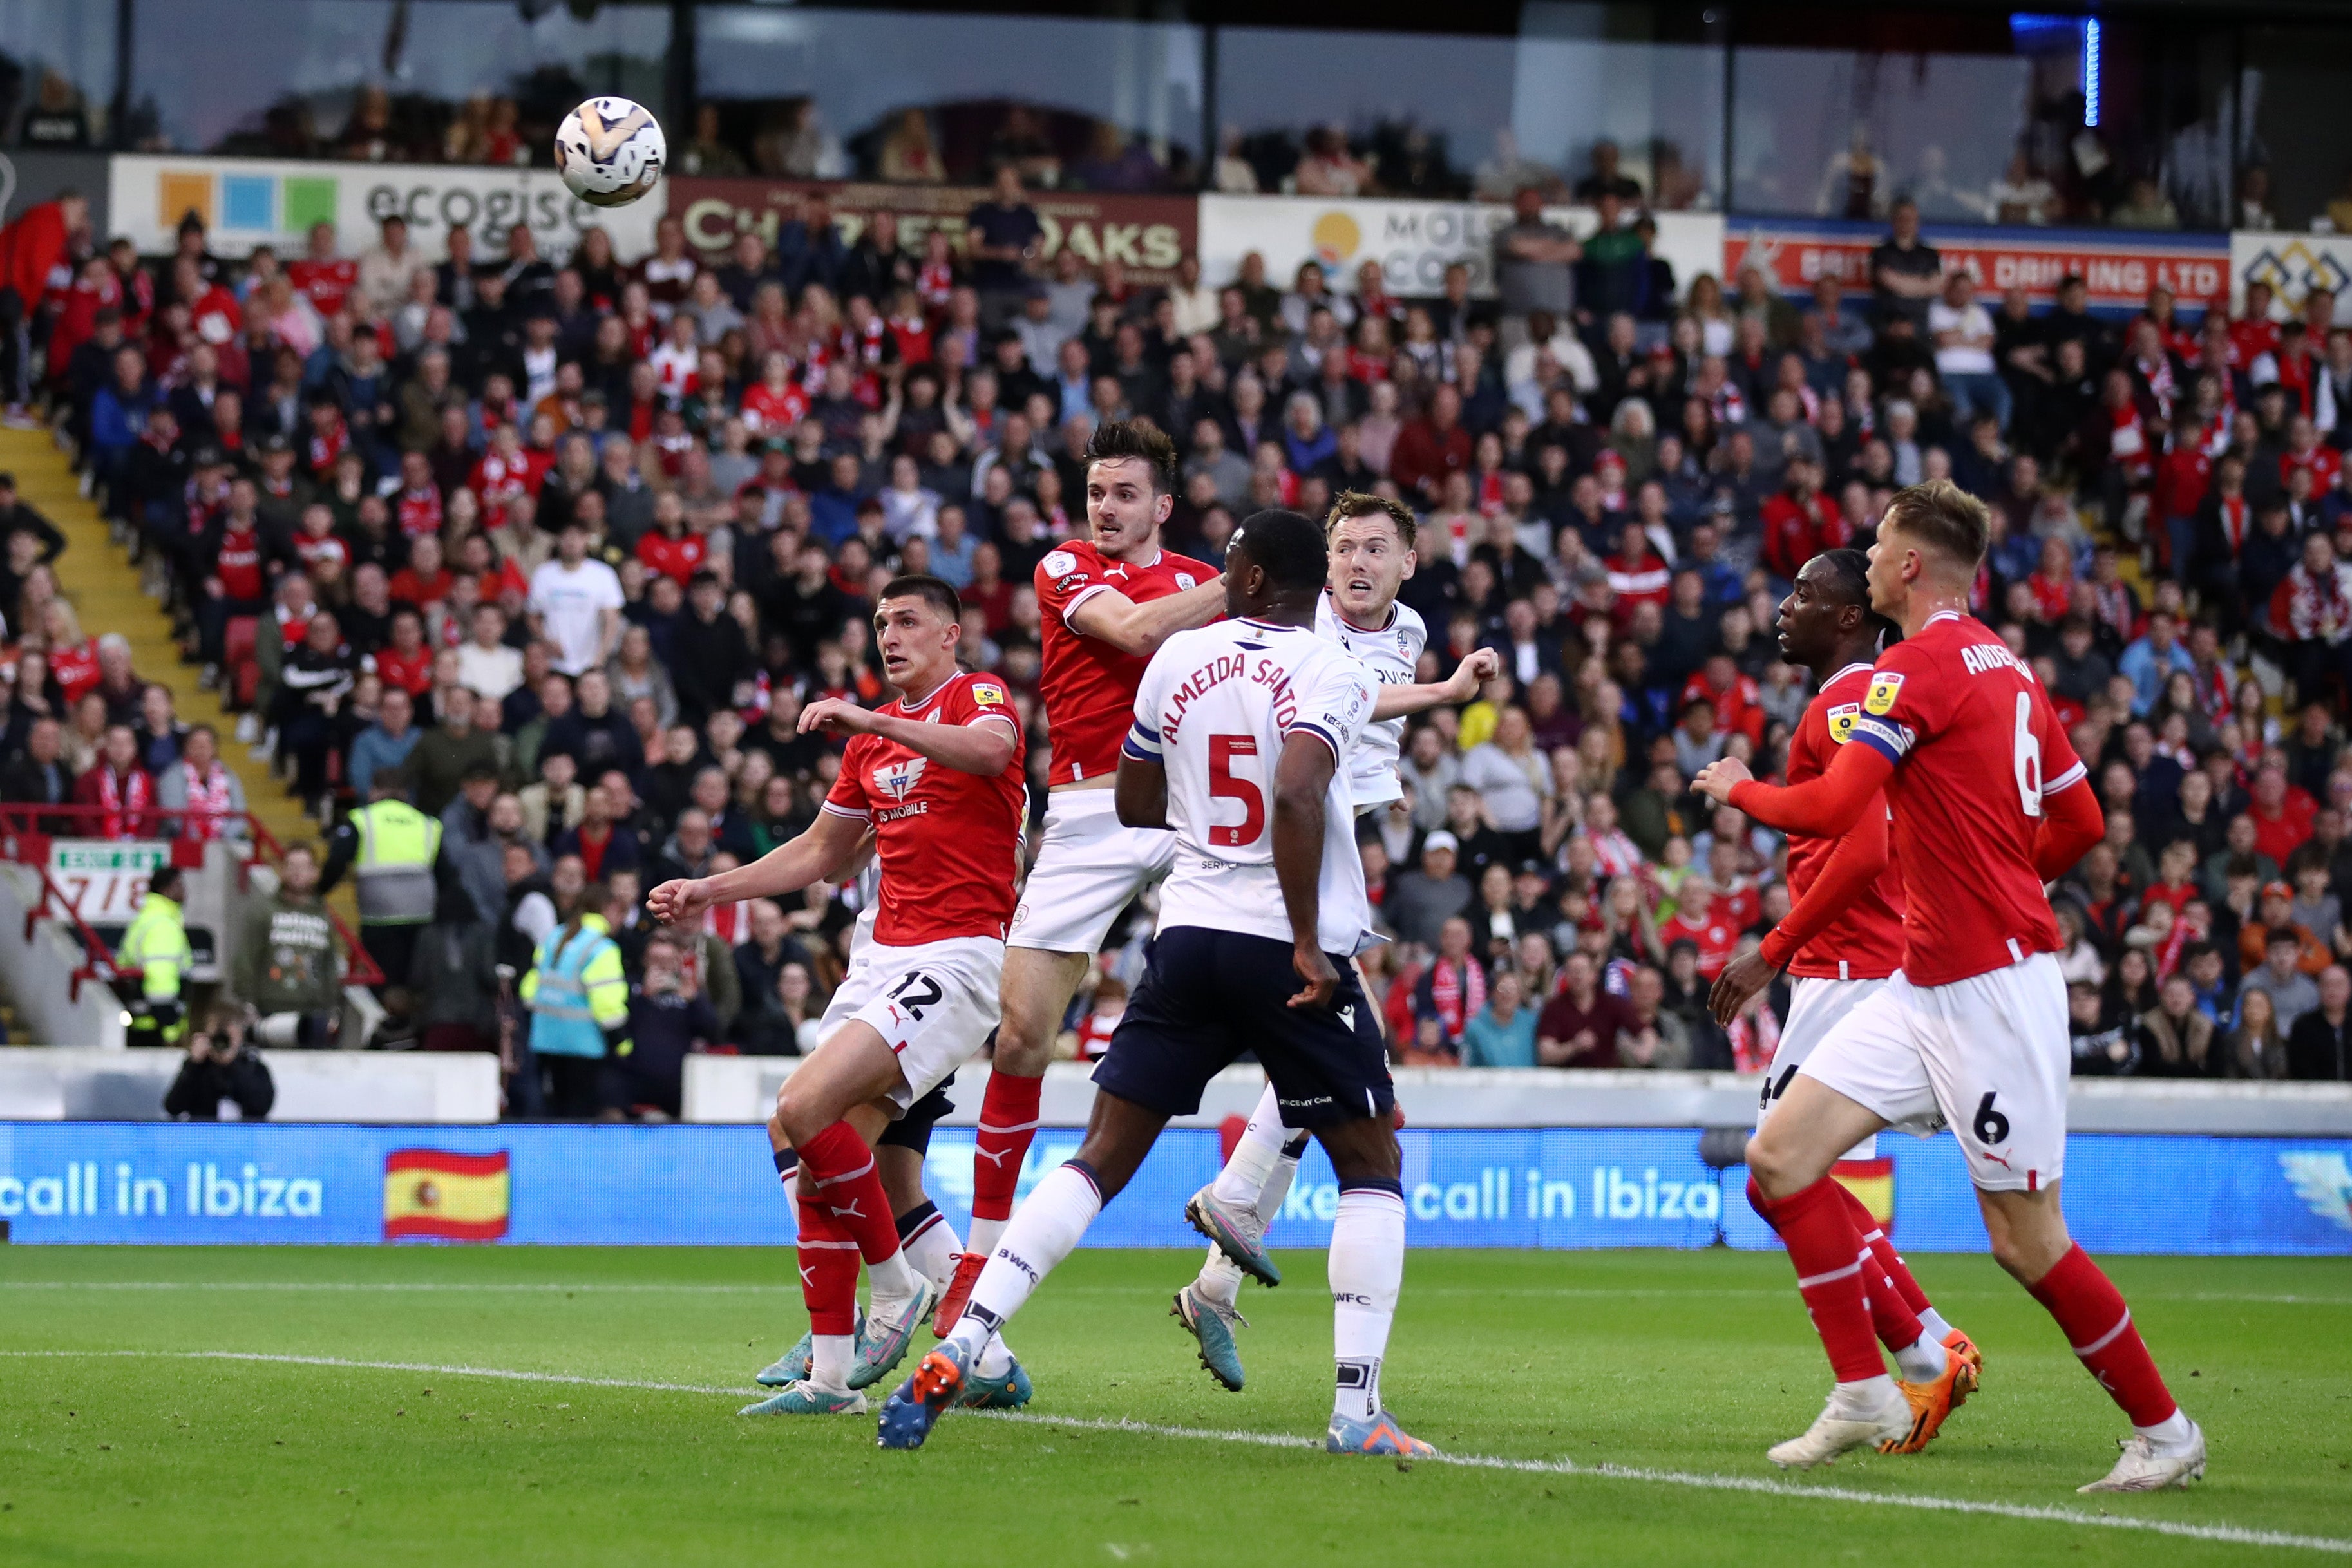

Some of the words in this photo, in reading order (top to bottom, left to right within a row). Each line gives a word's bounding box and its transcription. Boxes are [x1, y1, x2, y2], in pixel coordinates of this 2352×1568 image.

[1162, 653, 1245, 746] ALMEIDA
[2015, 691, 2042, 816] 6
[889, 801, 927, 820] MOBILE
[1208, 734, 1265, 847] 5
[887, 971, 942, 1021] 12
[1973, 1091, 2009, 1144] 6
[0, 1161, 99, 1216] call
[117, 1162, 167, 1217] in
[187, 1161, 323, 1218] Ibiza
[1412, 1166, 1511, 1221] call
[1527, 1167, 1575, 1219] in
[1593, 1166, 1719, 1219] Ibiza
[998, 1248, 1039, 1285] BWFC
[1334, 1292, 1372, 1306] WFC
